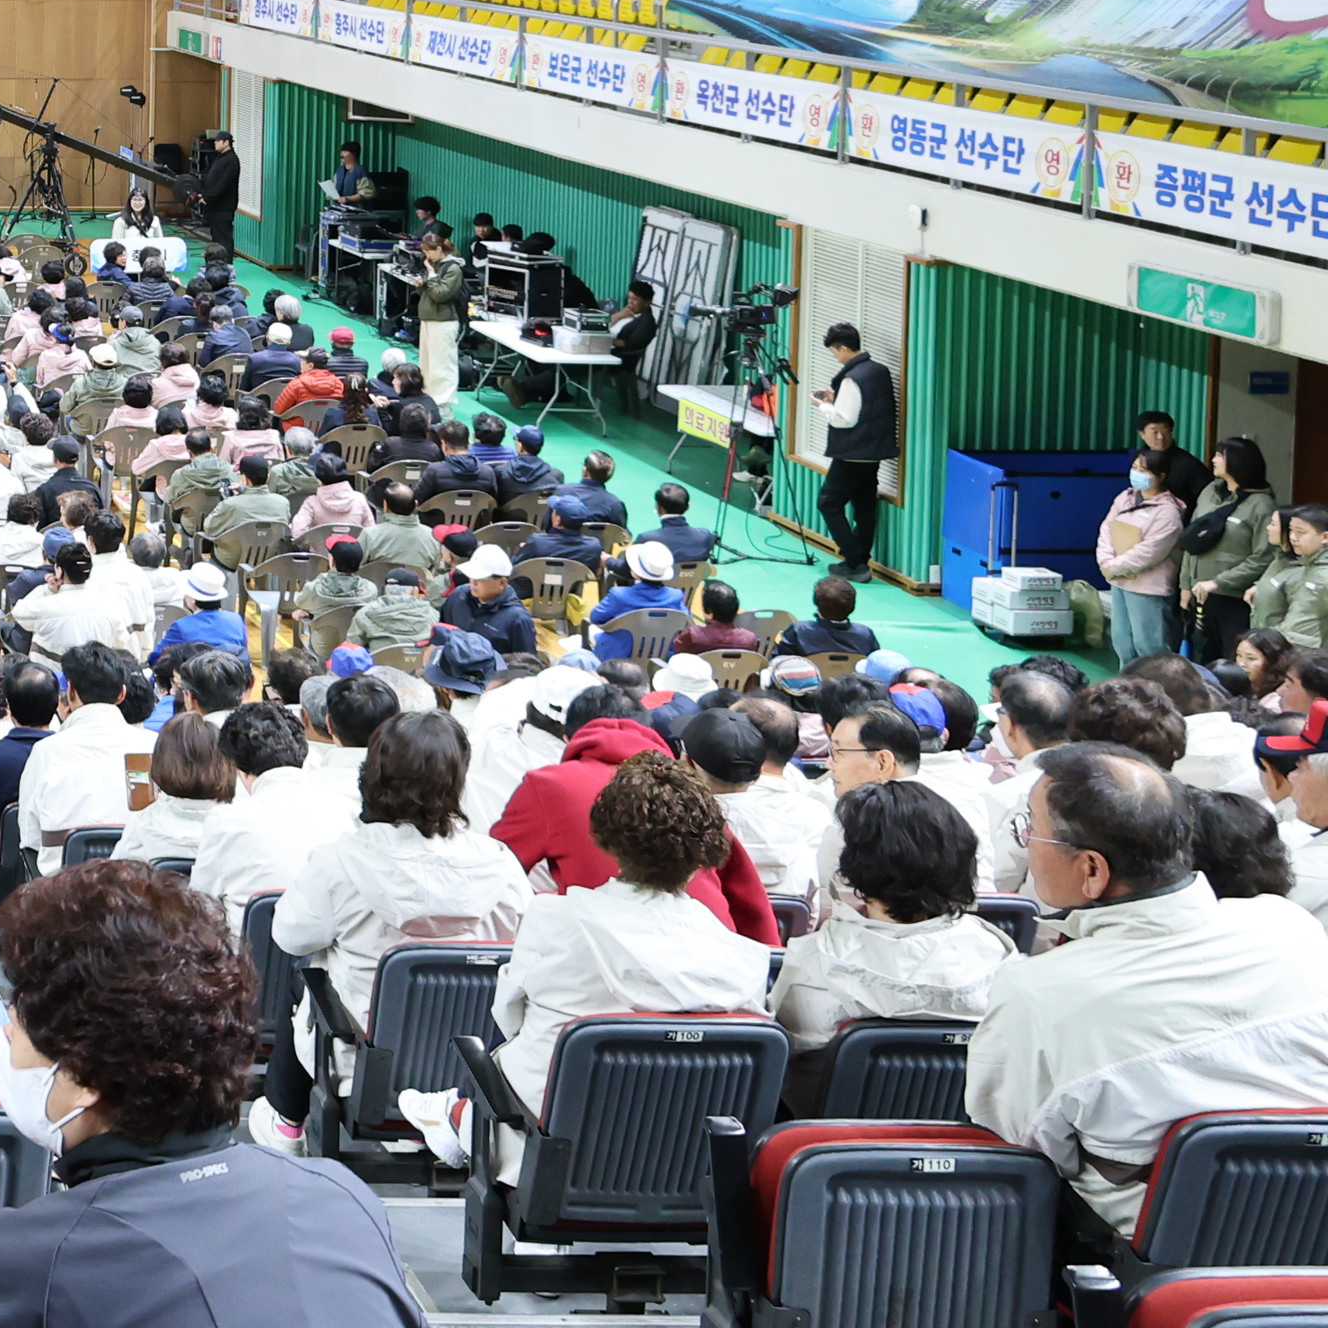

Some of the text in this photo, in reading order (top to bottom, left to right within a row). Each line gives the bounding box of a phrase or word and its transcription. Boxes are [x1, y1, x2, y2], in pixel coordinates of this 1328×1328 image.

[276, 1, 298, 25] 선수단
[335, 12, 385, 44] 충주시 선수단
[426, 29, 492, 66] 제천시 선수단
[547, 51, 626, 93] 보은군 선수단
[635, 71, 646, 93] 영
[674, 80, 685, 102] 환
[696, 78, 796, 128] 옥천군 선수단
[808, 103, 822, 128] 영
[860, 111, 875, 137] 환
[890, 113, 1026, 176] 영동군 선수단
[1044, 148, 1062, 177] 영
[1113, 159, 1133, 191] 환
[1154, 162, 1235, 220] 증평군
[684, 406, 731, 444] 의료지원
[666, 1032, 700, 1041] 가 100
[944, 1034, 954, 1044] 가
[1309, 1133, 1322, 1144] 가
[912, 1160, 951, 1170] 가 110
